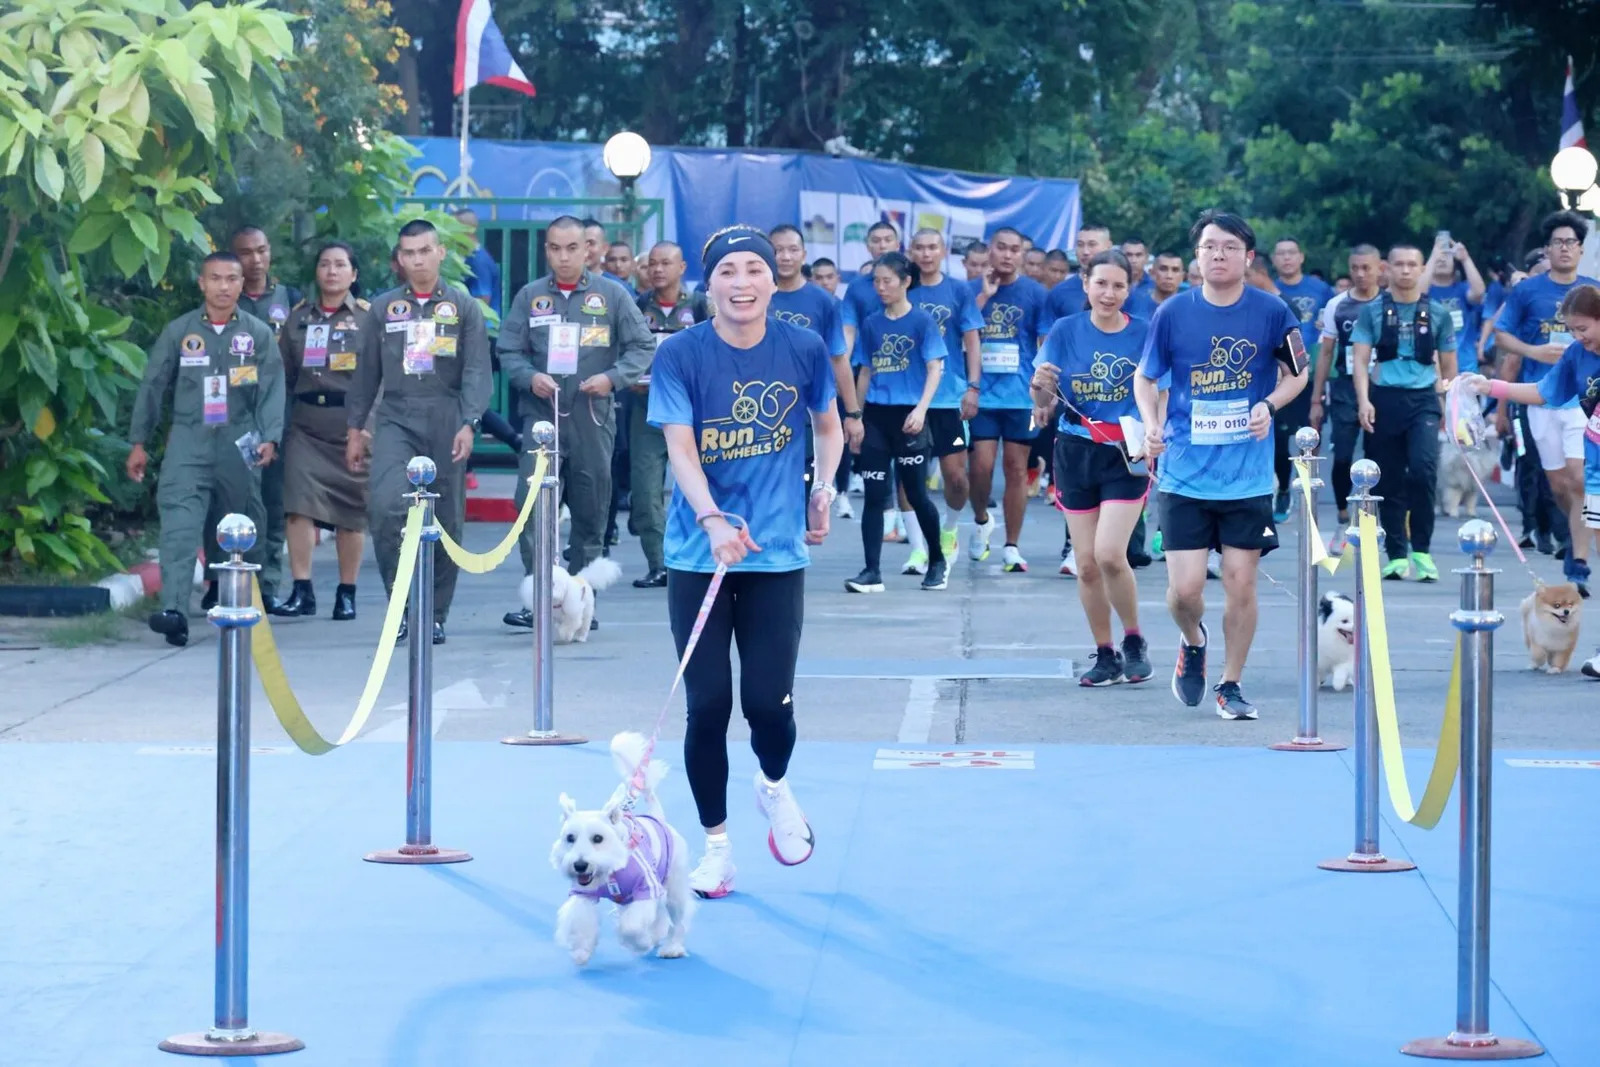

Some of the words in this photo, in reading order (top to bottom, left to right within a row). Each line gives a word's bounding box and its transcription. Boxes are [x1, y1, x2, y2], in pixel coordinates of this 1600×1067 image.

[1190, 370, 1225, 387] Run
[1072, 379, 1104, 394] Run
[1202, 381, 1236, 394] WHEELS
[1194, 420, 1218, 430] M-19
[1224, 418, 1248, 429] 0110
[701, 427, 754, 452] Run
[701, 453, 718, 464] for
[722, 442, 772, 460] WHEELS
[898, 454, 924, 466] PRO
